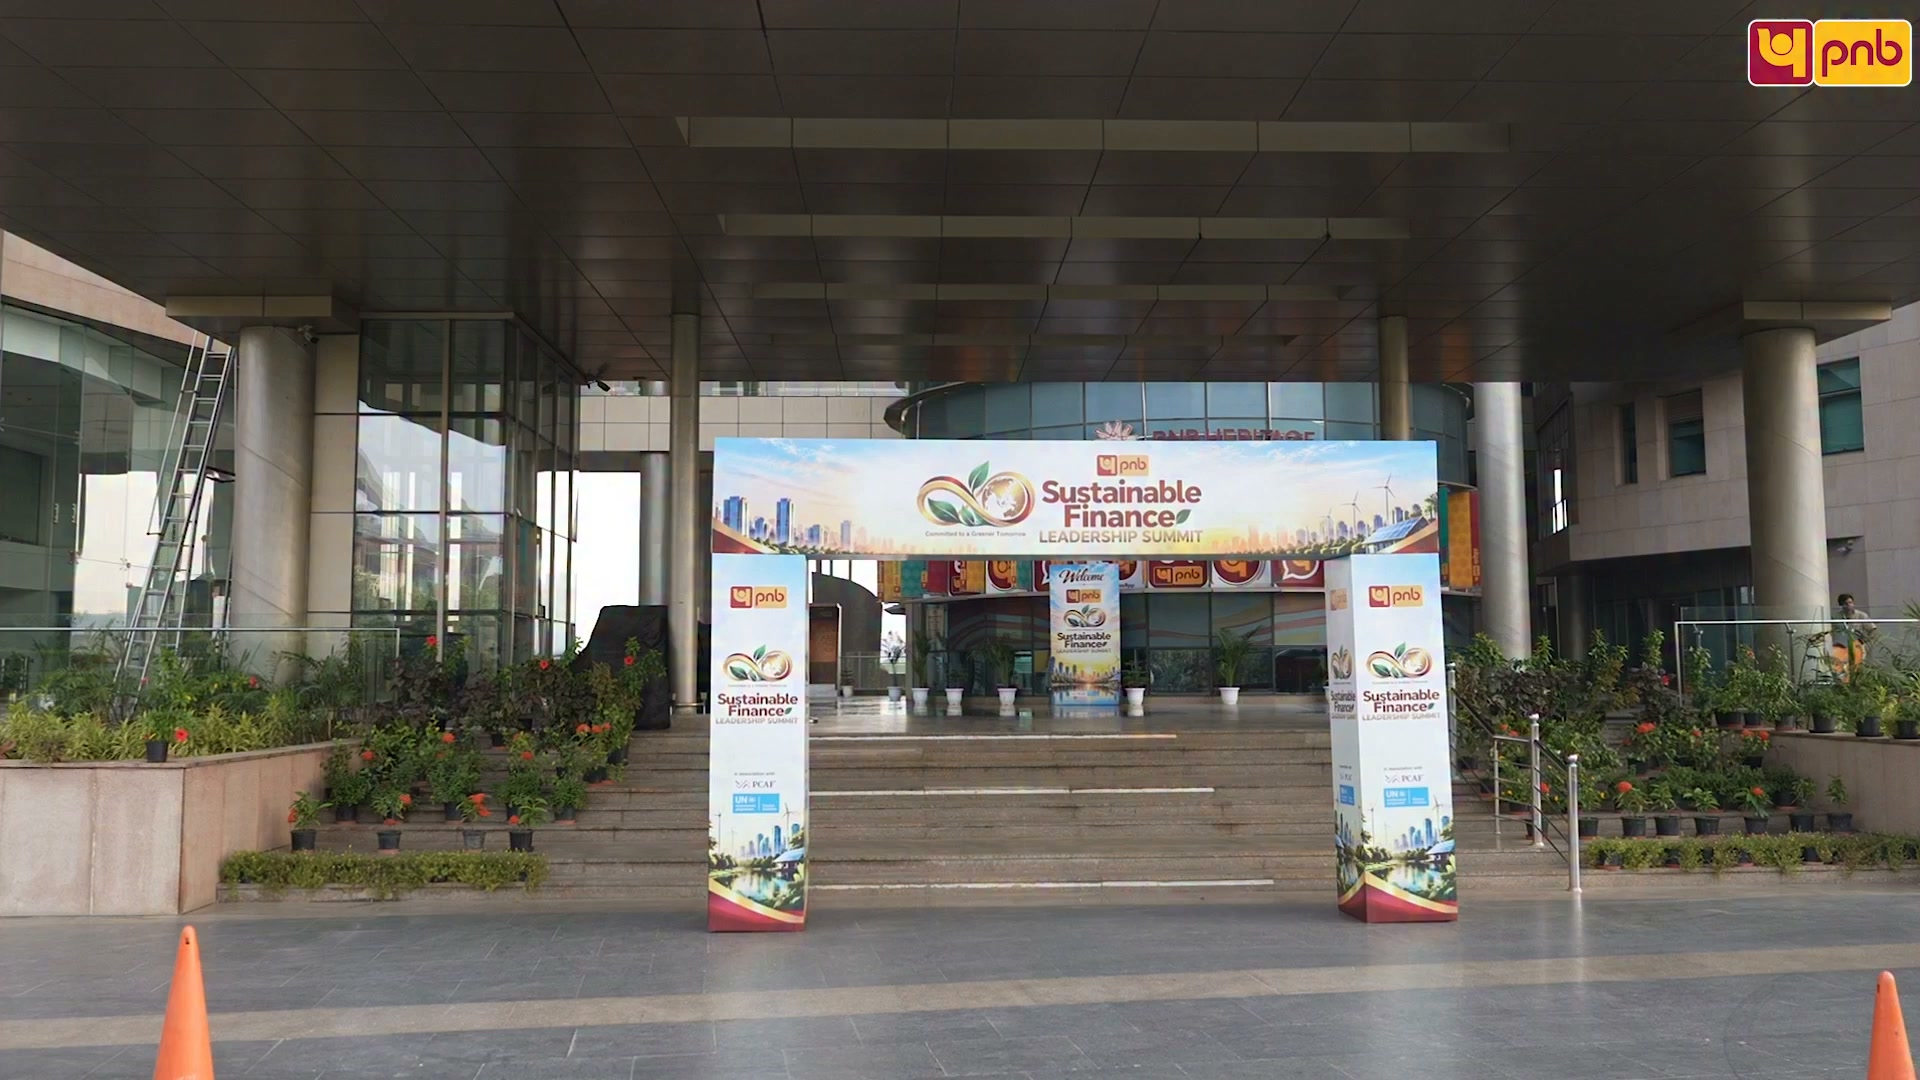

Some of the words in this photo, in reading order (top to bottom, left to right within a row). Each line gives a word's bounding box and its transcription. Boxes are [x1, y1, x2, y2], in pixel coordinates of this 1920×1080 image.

[1120, 457, 1147, 474] pnb
[1042, 478, 1202, 504] Sustainable
[1064, 503, 1175, 528] Finance
[1039, 530, 1138, 543] LEADERSHIP
[1142, 530, 1203, 543] SUMMIT
[1059, 568, 1104, 584] Welcome
[1175, 569, 1200, 582] pnb
[755, 589, 785, 606] pnb
[1393, 588, 1421, 605] pnb
[1057, 632, 1112, 641] Sustainable
[1064, 640, 1102, 648] Finance
[717, 692, 798, 705] Sustainable
[1363, 689, 1440, 702] Sustainable
[728, 704, 785, 717] Finance
[1374, 700, 1428, 713] Finance
[752, 780, 776, 788] PCAF
